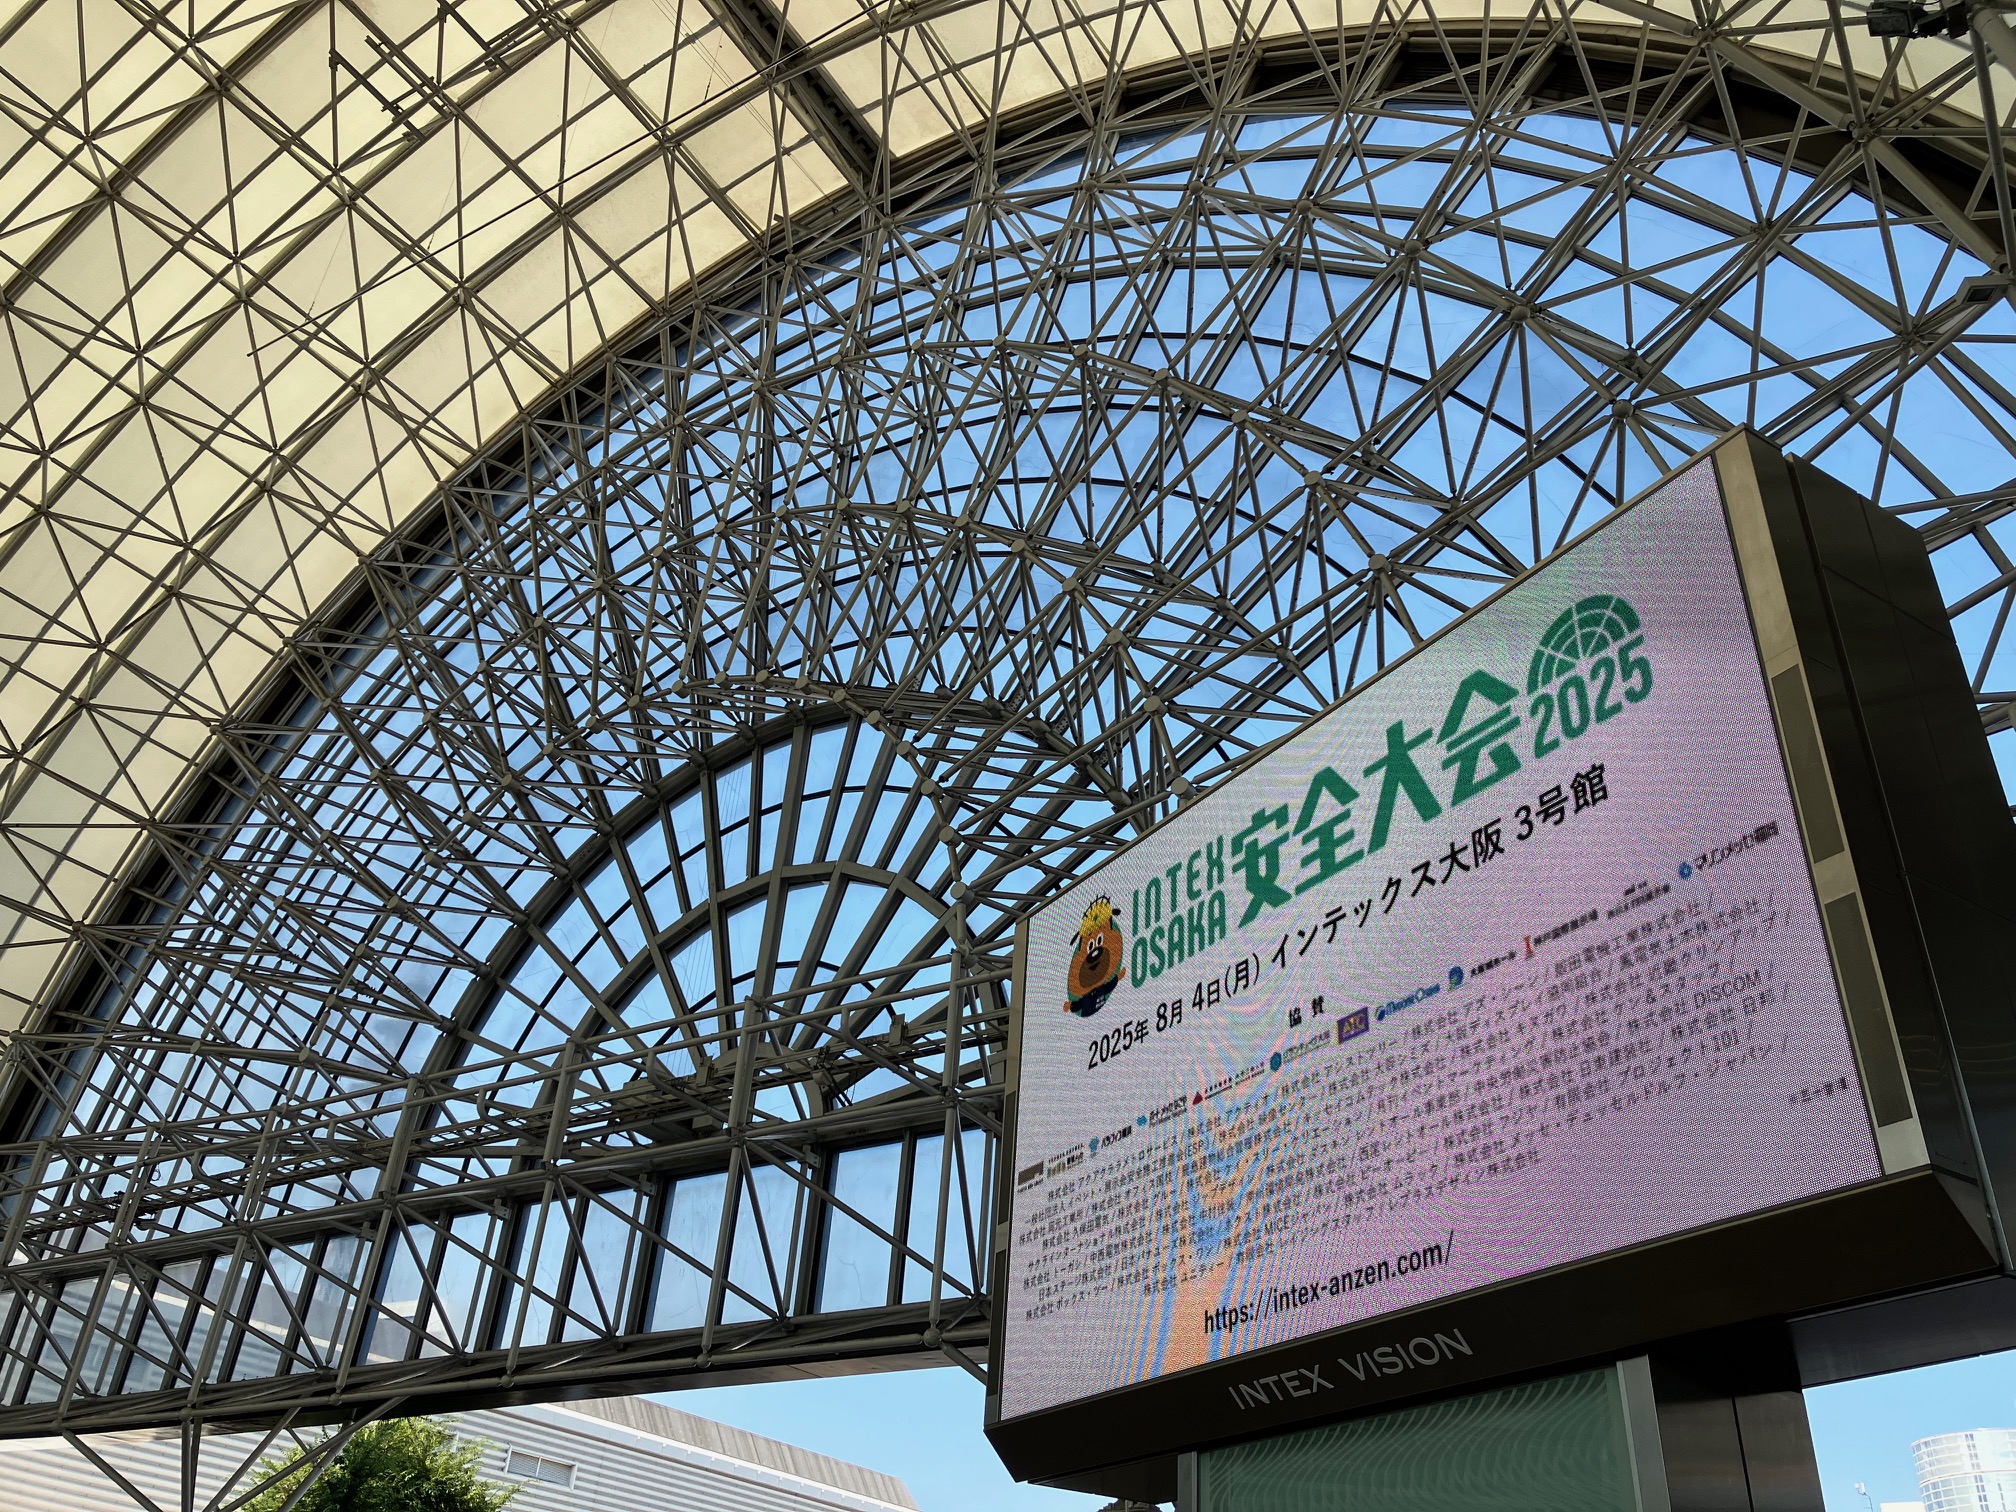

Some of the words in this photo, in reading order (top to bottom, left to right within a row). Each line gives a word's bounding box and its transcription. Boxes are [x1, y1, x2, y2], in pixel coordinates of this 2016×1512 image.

[1530, 635, 1652, 758] 2025
[1231, 671, 1519, 926] 安全大会
[1087, 1018, 1149, 1070] 2025年
[1155, 997, 1182, 1033] 8月
[1191, 952, 1260, 1011] 4日(月)
[1271, 817, 1504, 968] インテックス大阪
[1514, 763, 1608, 841] 3号館
[1130, 890, 1226, 988] OSAKA
[1131, 835, 1224, 936] INTEX
[1019, 1223, 1045, 1246] 株式会社
[1092, 1191, 1120, 1216] 株式会社
[1460, 1026, 1510, 1061] 株式会社
[1584, 970, 1643, 1009] 株式会社
[1023, 1269, 1049, 1291] 株式会社
[1162, 1212, 1195, 1238] 株式会社
[1519, 1065, 1575, 1102] 株式会社
[1671, 1003, 1735, 1044] 株式会社
[1042, 1228, 1070, 1251] 株式会社
[1118, 1195, 1148, 1221] 株式会社
[1186, 1165, 1221, 1192] 株式会社
[1552, 1006, 1608, 1044] 株式会社
[1048, 1180, 1074, 1203] 株式会社
[1188, 1113, 1221, 1141] 株式会社
[1281, 1069, 1320, 1099] 株式会社
[1412, 1007, 1458, 1041] 株式会社
[1156, 1196, 1188, 1222] 株式会社
[1266, 1150, 1305, 1179] 株式会社
[1627, 997, 1688, 1036] 株式会社
[1693, 968, 1761, 1010] DISCOM
[1219, 1116, 1253, 1144] 株式会社
[1328, 1066, 1369, 1097] 株式会社
[1313, 1170, 1355, 1200] 株式会社
[1443, 1118, 1494, 1152] 株式会社
[1555, 1075, 1610, 1111] 有限会社
[1025, 1300, 1053, 1322] 株式会社
[1117, 1265, 1149, 1290] 株式会社
[1224, 1224, 1261, 1252] 株式会社
[1344, 1178, 1388, 1209] 株式会社
[1454, 1136, 1505, 1170] 株式会社
[1144, 1272, 1176, 1297] 株式会社
[1236, 1238, 1274, 1266] 有限会社
[1204, 1231, 1453, 1334] https://intex-anzen.com/
[1228, 1364, 1335, 1410] INTEX
[1337, 1328, 1474, 1381] VISION
